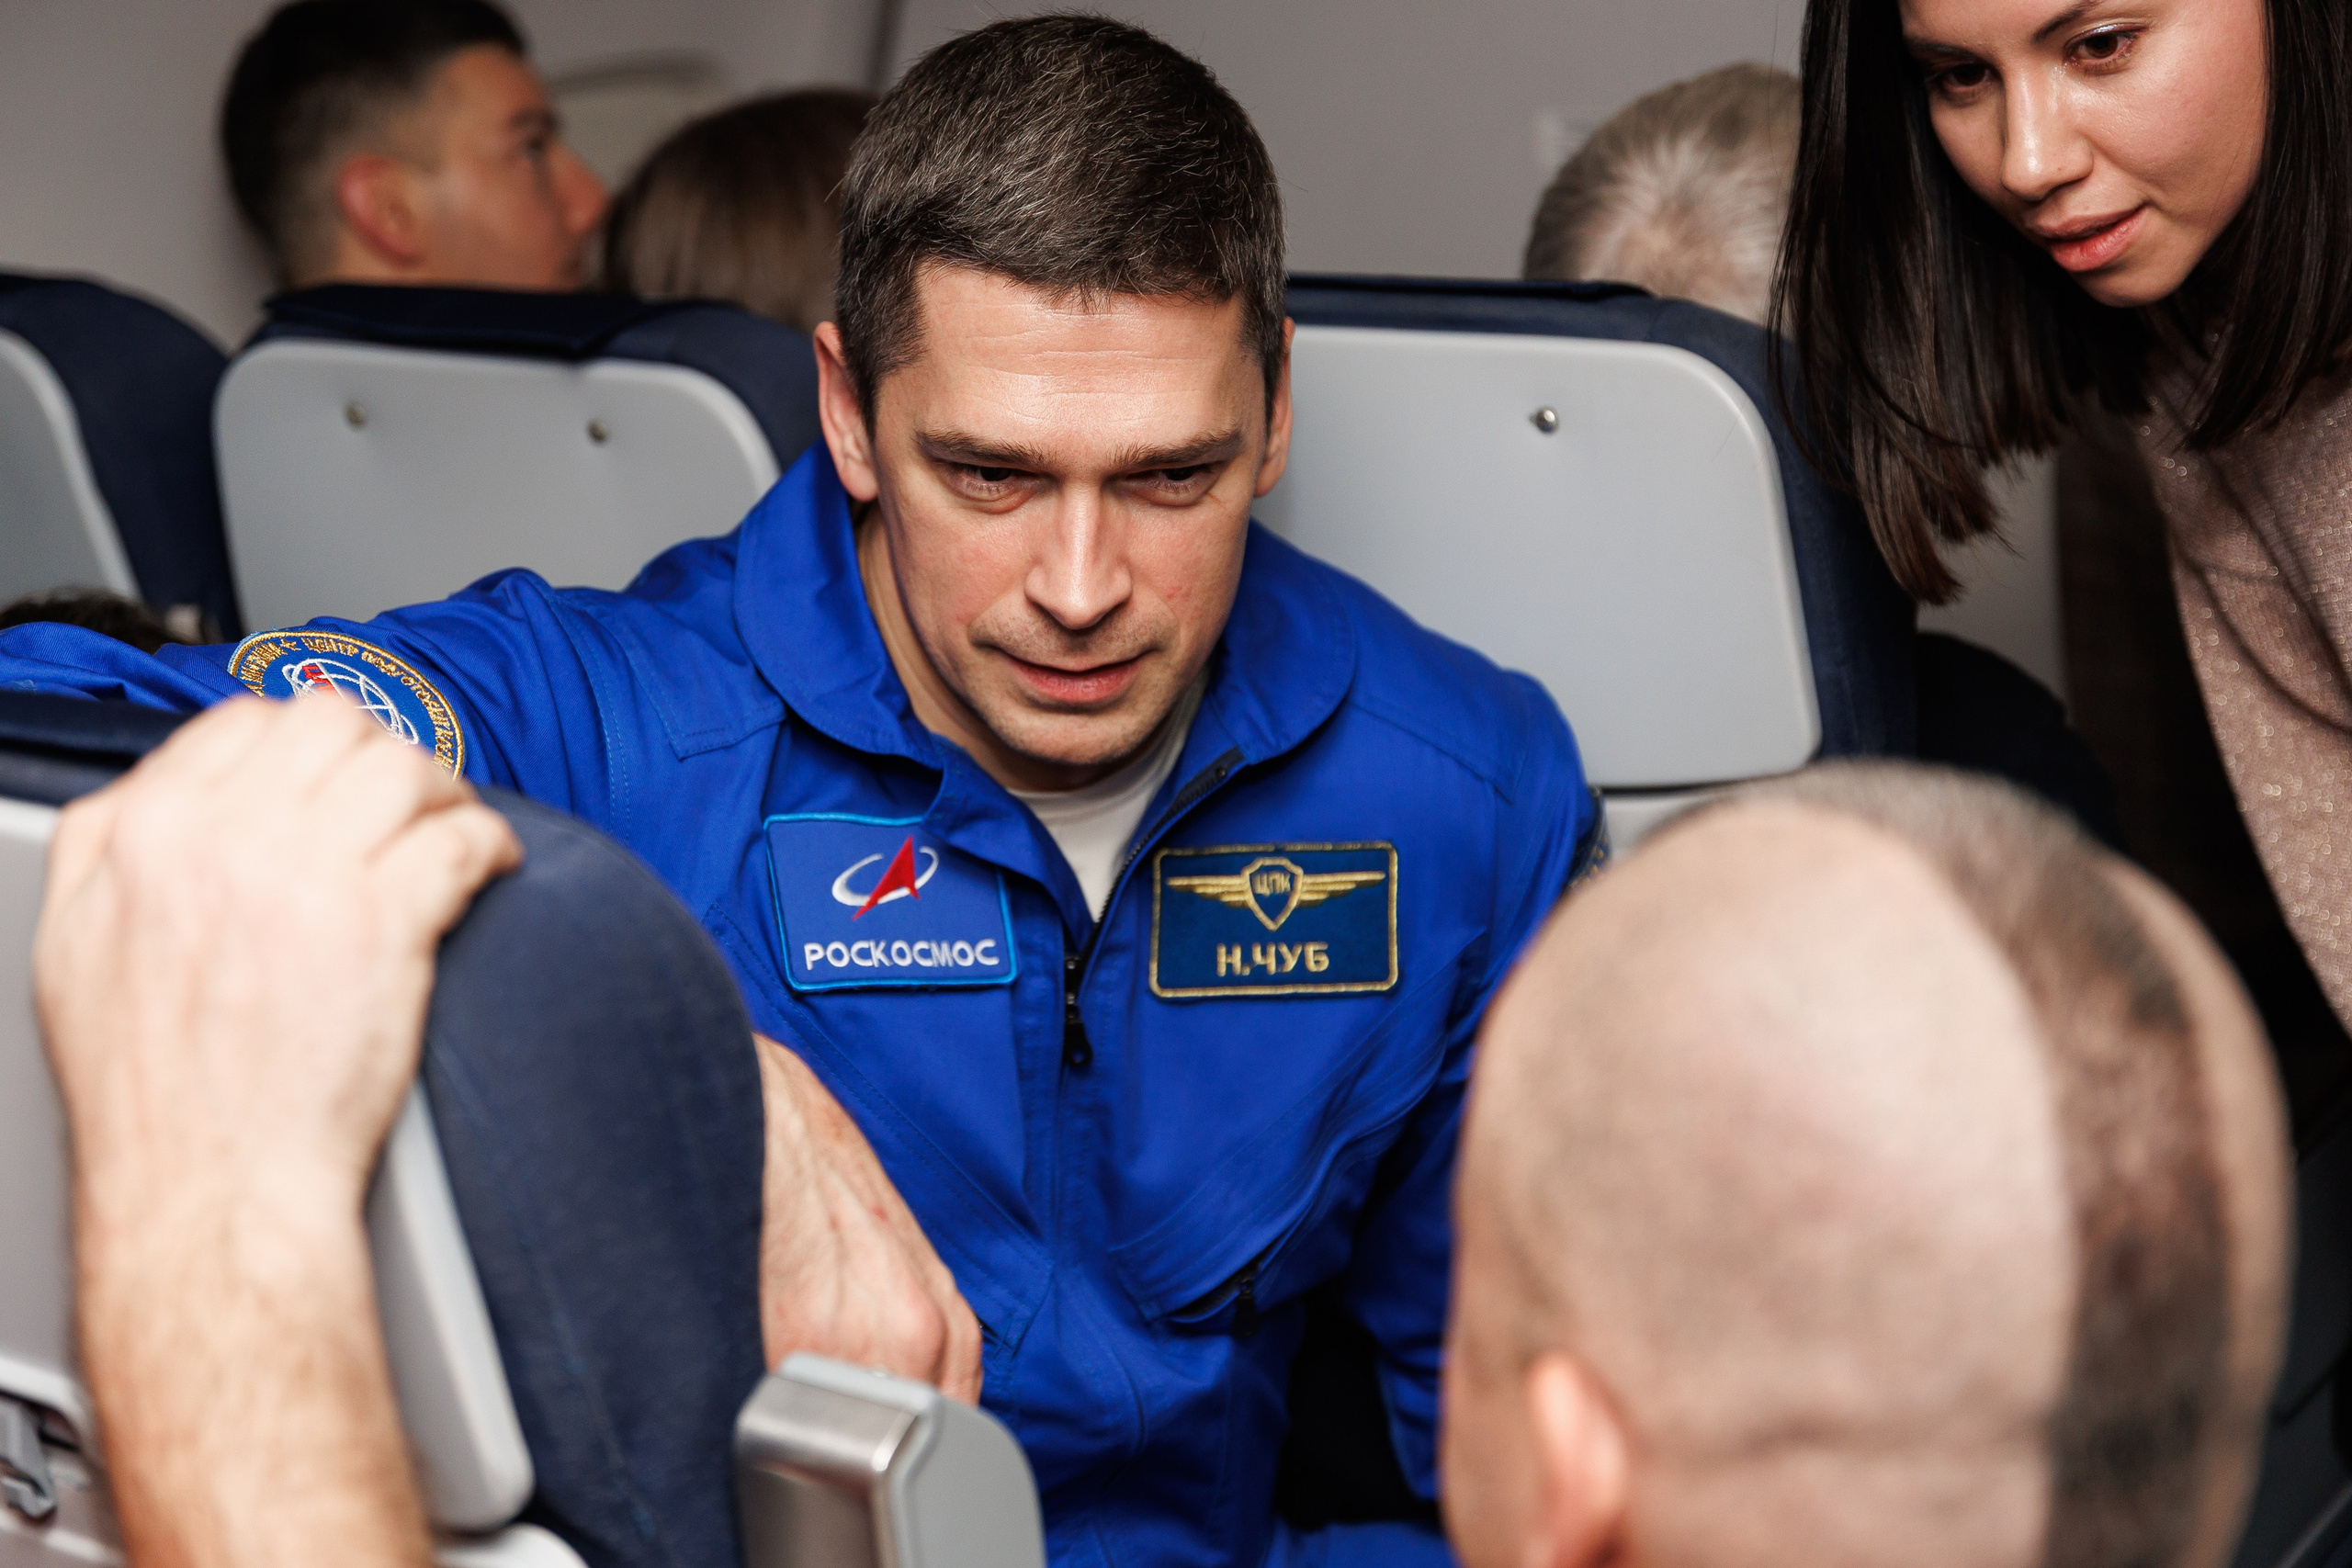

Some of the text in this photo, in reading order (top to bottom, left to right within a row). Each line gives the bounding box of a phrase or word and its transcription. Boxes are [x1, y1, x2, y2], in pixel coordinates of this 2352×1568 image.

[300, 637, 359, 657] ЦЕНТР
[1252, 871, 1291, 897] ЦПК
[804, 938, 1000, 970] РОСКОСМОС
[1216, 941, 1329, 976] Н.ЧУБ
